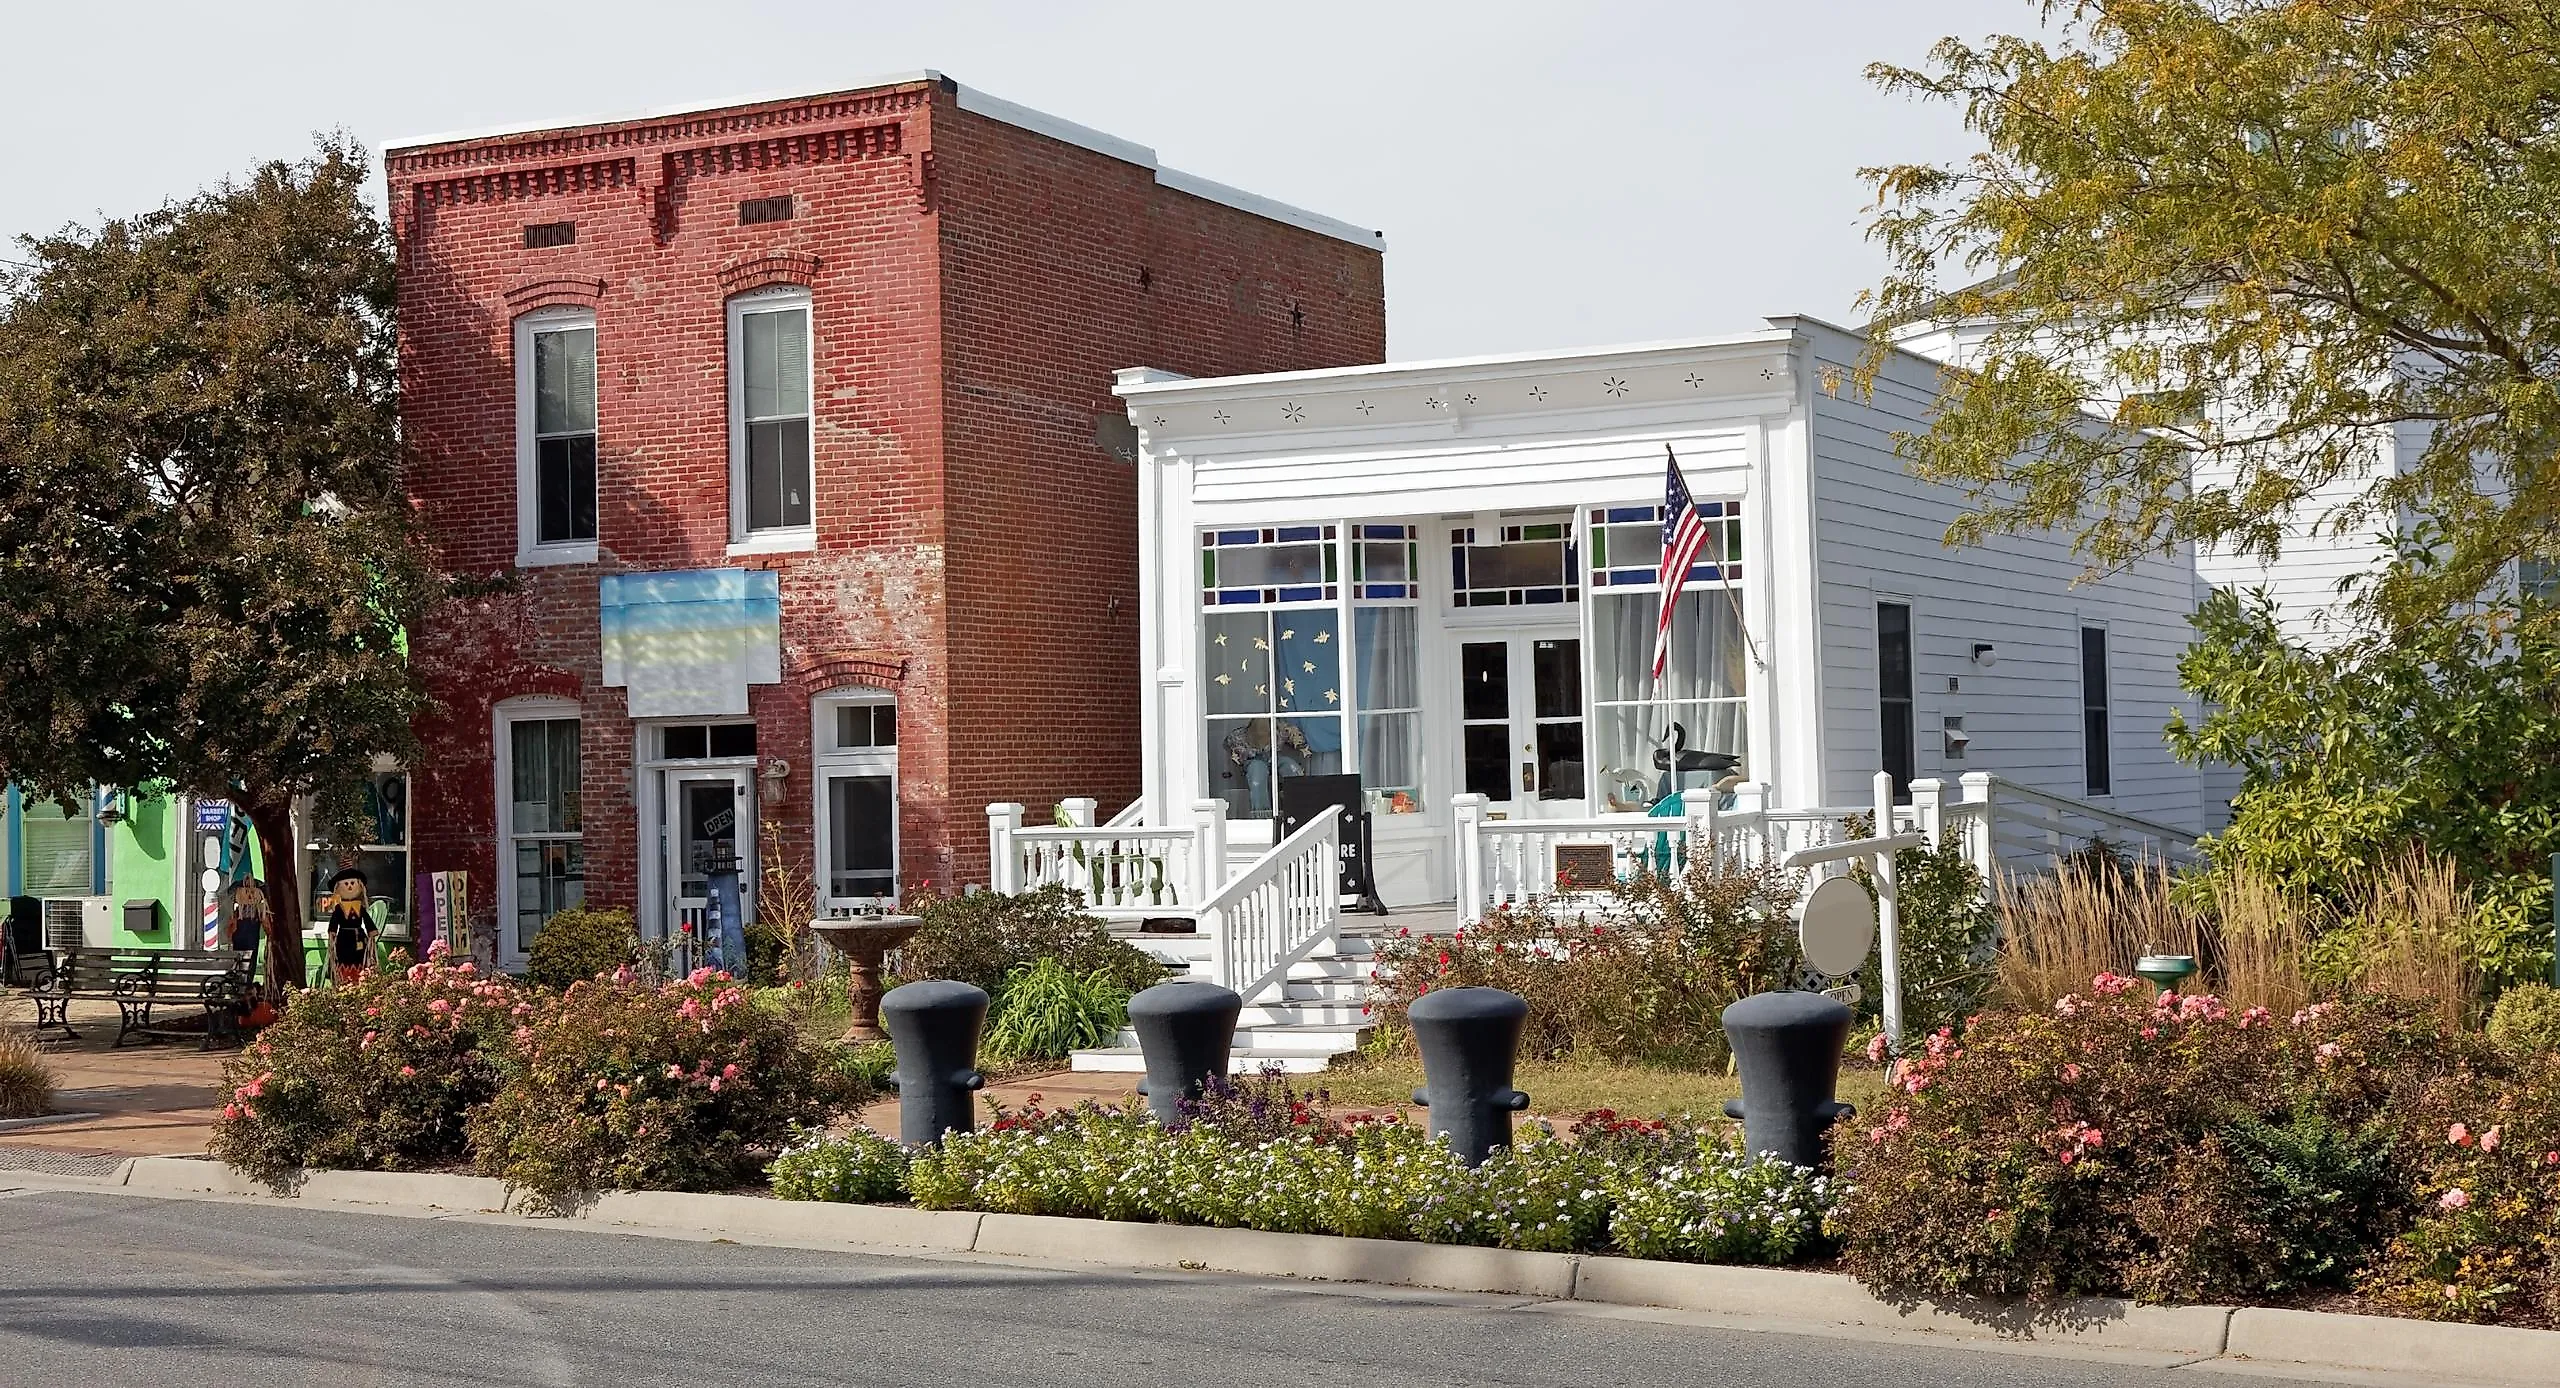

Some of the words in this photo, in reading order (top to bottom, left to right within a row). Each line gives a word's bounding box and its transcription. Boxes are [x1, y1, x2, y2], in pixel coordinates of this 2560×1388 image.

[201, 807, 225, 815] BARBER
[706, 810, 734, 833] OPEN
[1830, 988, 1854, 1003] OPEN
